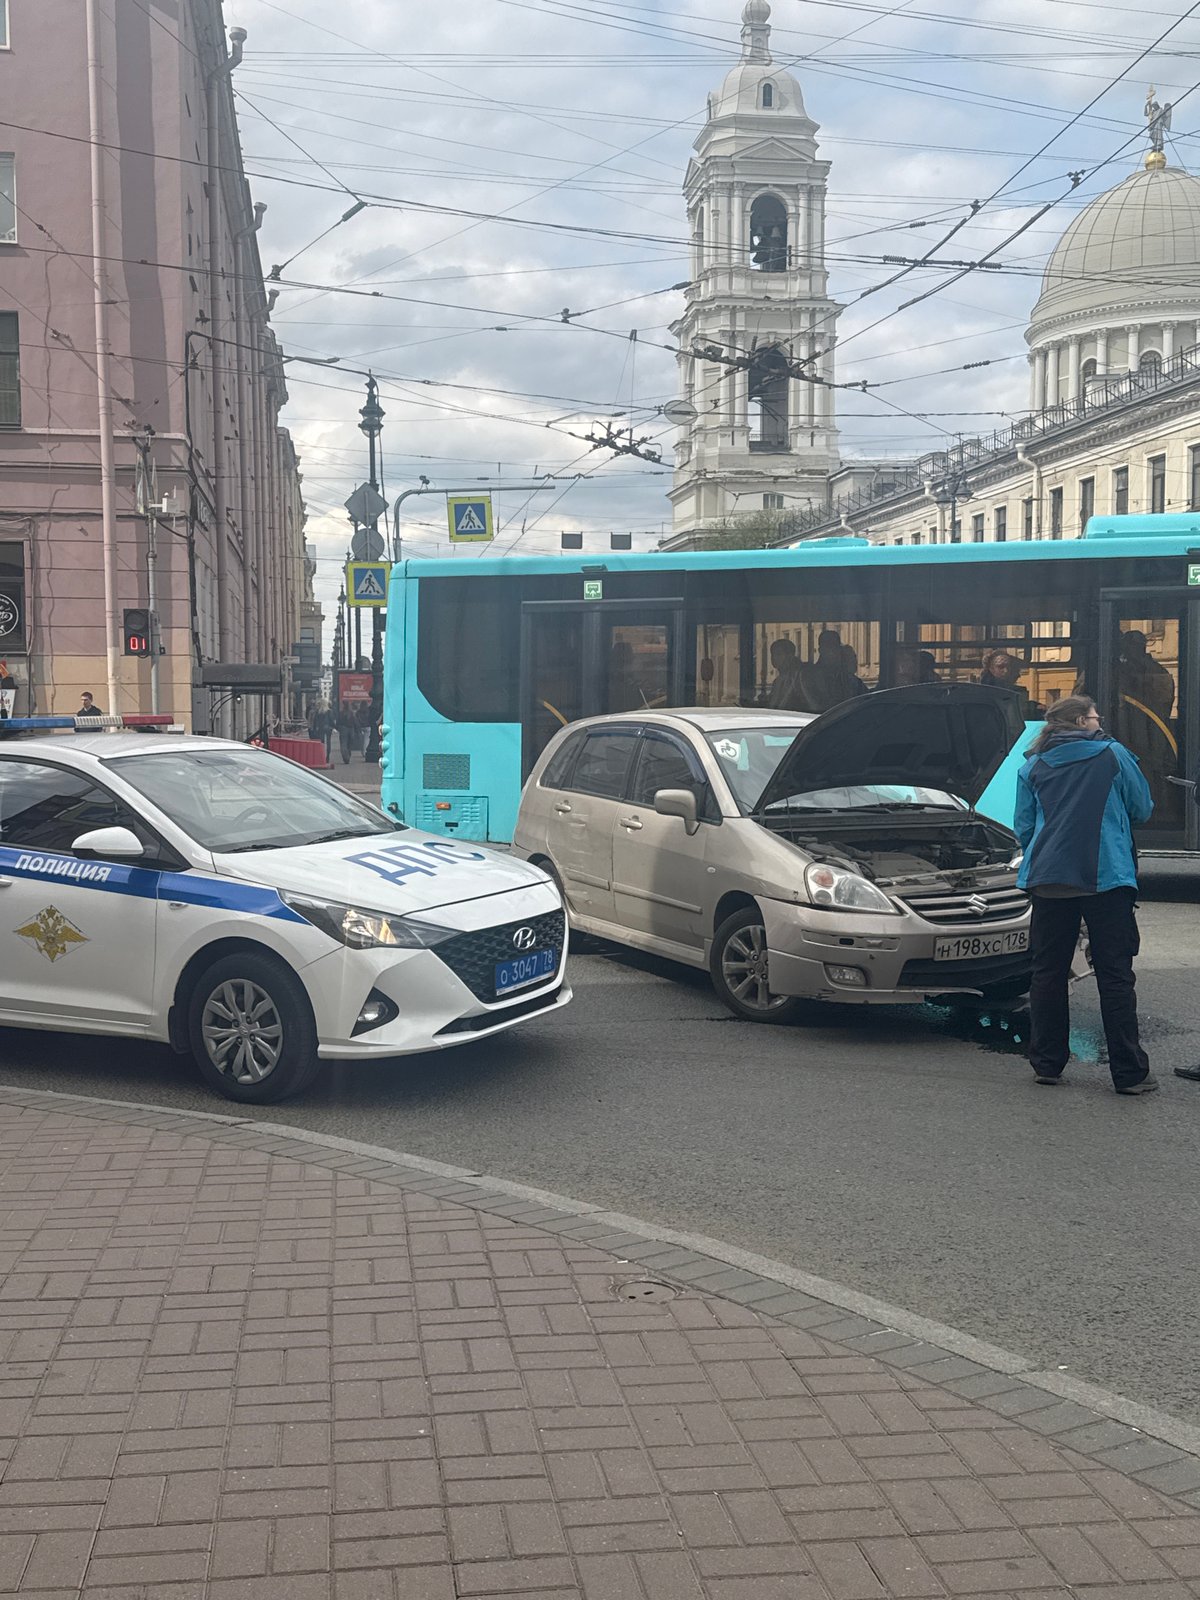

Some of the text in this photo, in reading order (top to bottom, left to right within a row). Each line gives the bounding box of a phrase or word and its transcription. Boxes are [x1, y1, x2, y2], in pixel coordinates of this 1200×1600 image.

[130, 636, 146, 651] 01
[14, 854, 112, 882] ПОЛИЦИЯ
[341, 841, 486, 886] ДПС
[1005, 932, 1025, 946] 178
[512, 955, 538, 981] 3047
[543, 950, 553, 966] 78
